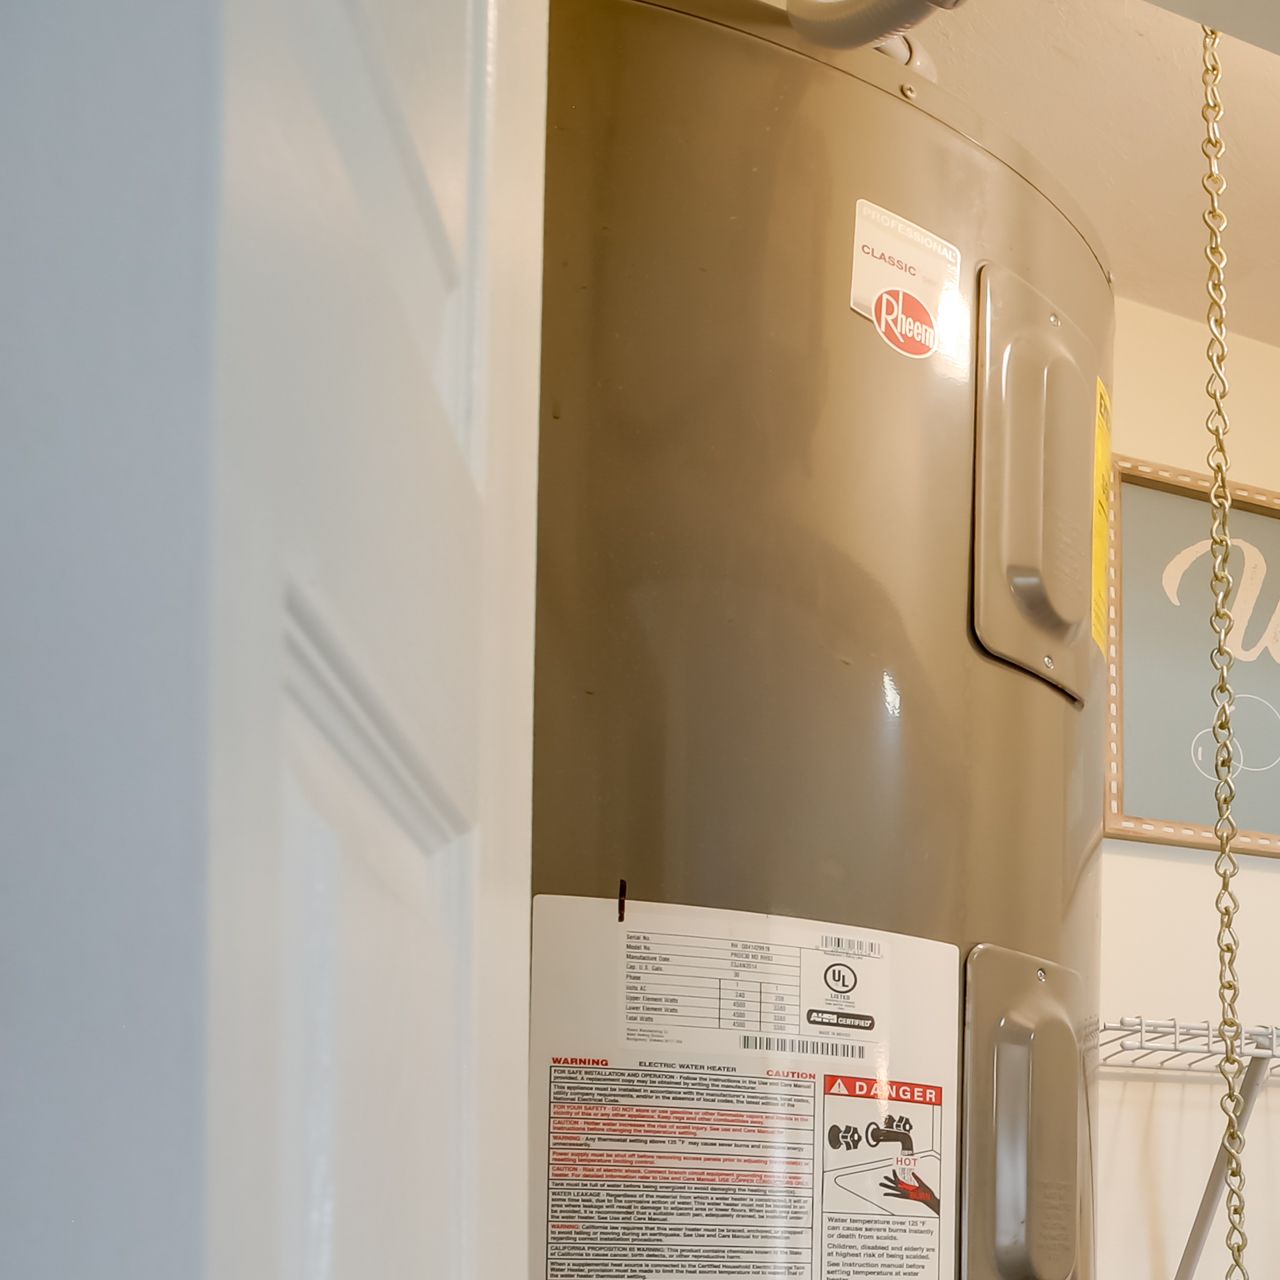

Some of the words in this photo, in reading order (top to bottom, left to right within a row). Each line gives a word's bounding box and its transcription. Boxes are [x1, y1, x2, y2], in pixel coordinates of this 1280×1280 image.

[861, 244, 916, 276] CLASSIC
[881, 289, 934, 348] Rheem
[832, 969, 849, 987] UL
[552, 1057, 608, 1067] WARNING
[639, 1061, 676, 1069] ELECTRIC
[679, 1063, 704, 1071] WATER
[707, 1065, 736, 1073] HEATER
[767, 1069, 816, 1079] CAUTION
[855, 1082, 936, 1102] DANGER
[896, 1157, 917, 1166] HOT
